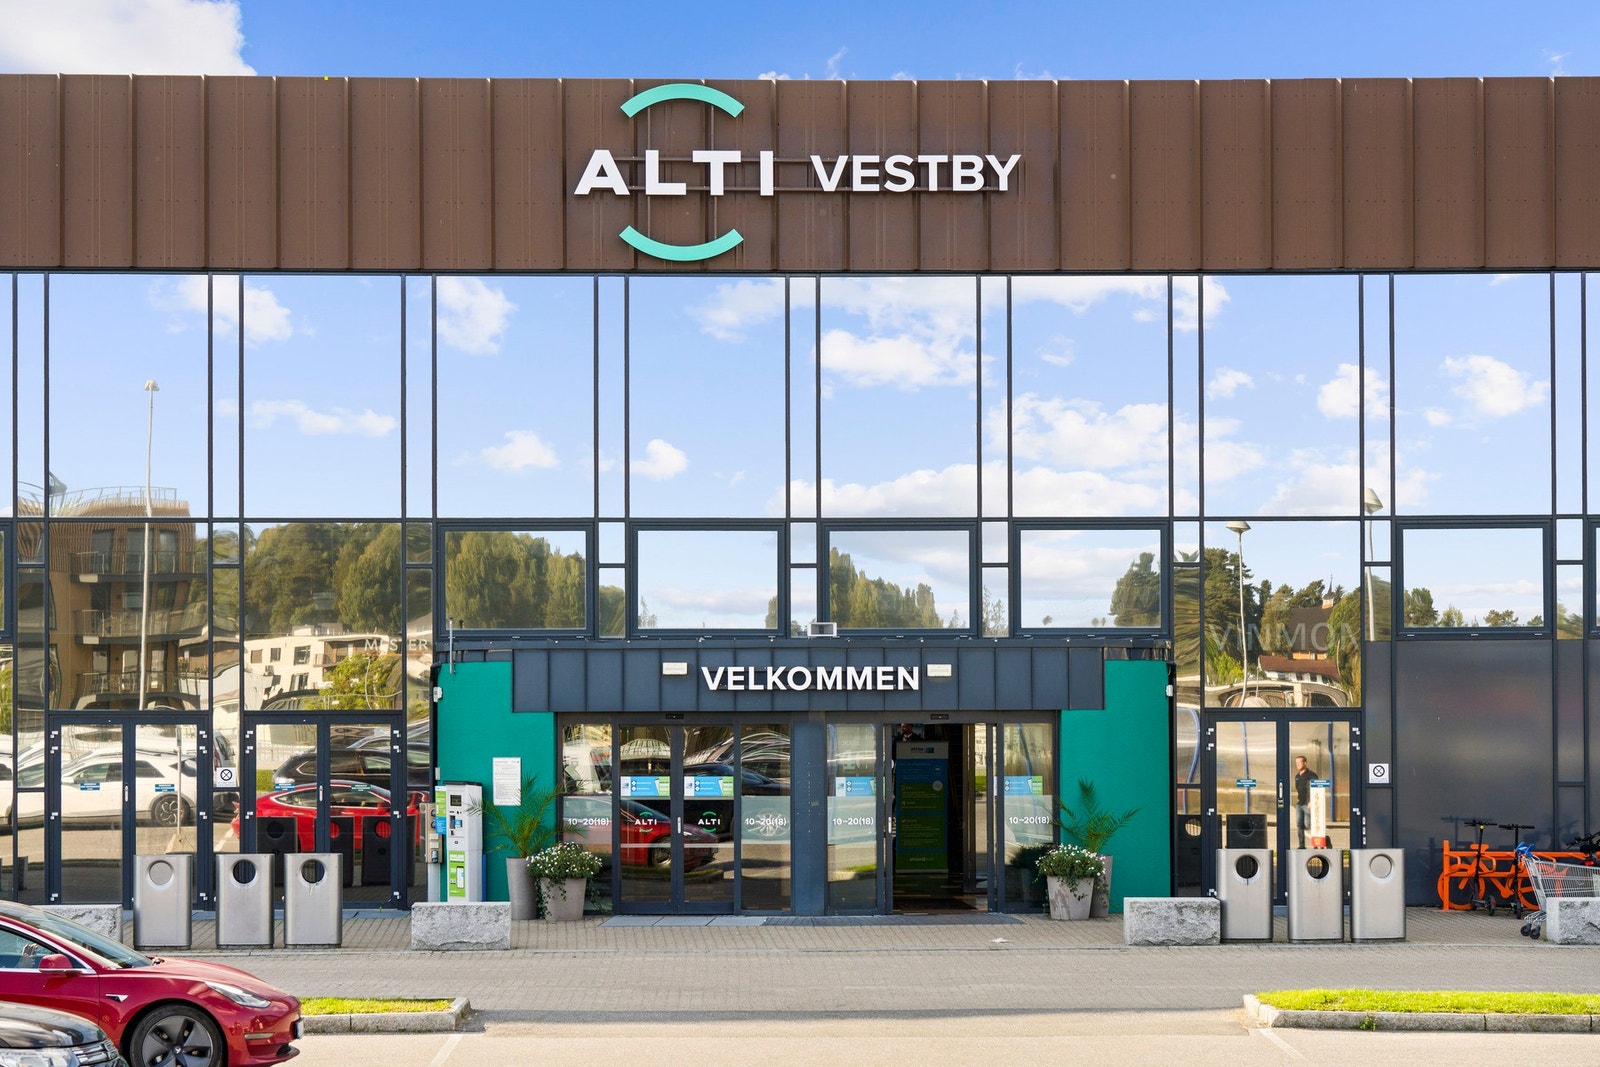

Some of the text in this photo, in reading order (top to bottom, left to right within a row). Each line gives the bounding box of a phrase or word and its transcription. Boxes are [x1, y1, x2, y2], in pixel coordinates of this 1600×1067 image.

[573, 149, 1022, 196] ALTI VESTBY
[701, 666, 920, 691] VELKOMMEN
[634, 818, 657, 826] ALTI
[697, 818, 721, 826] ALTI
